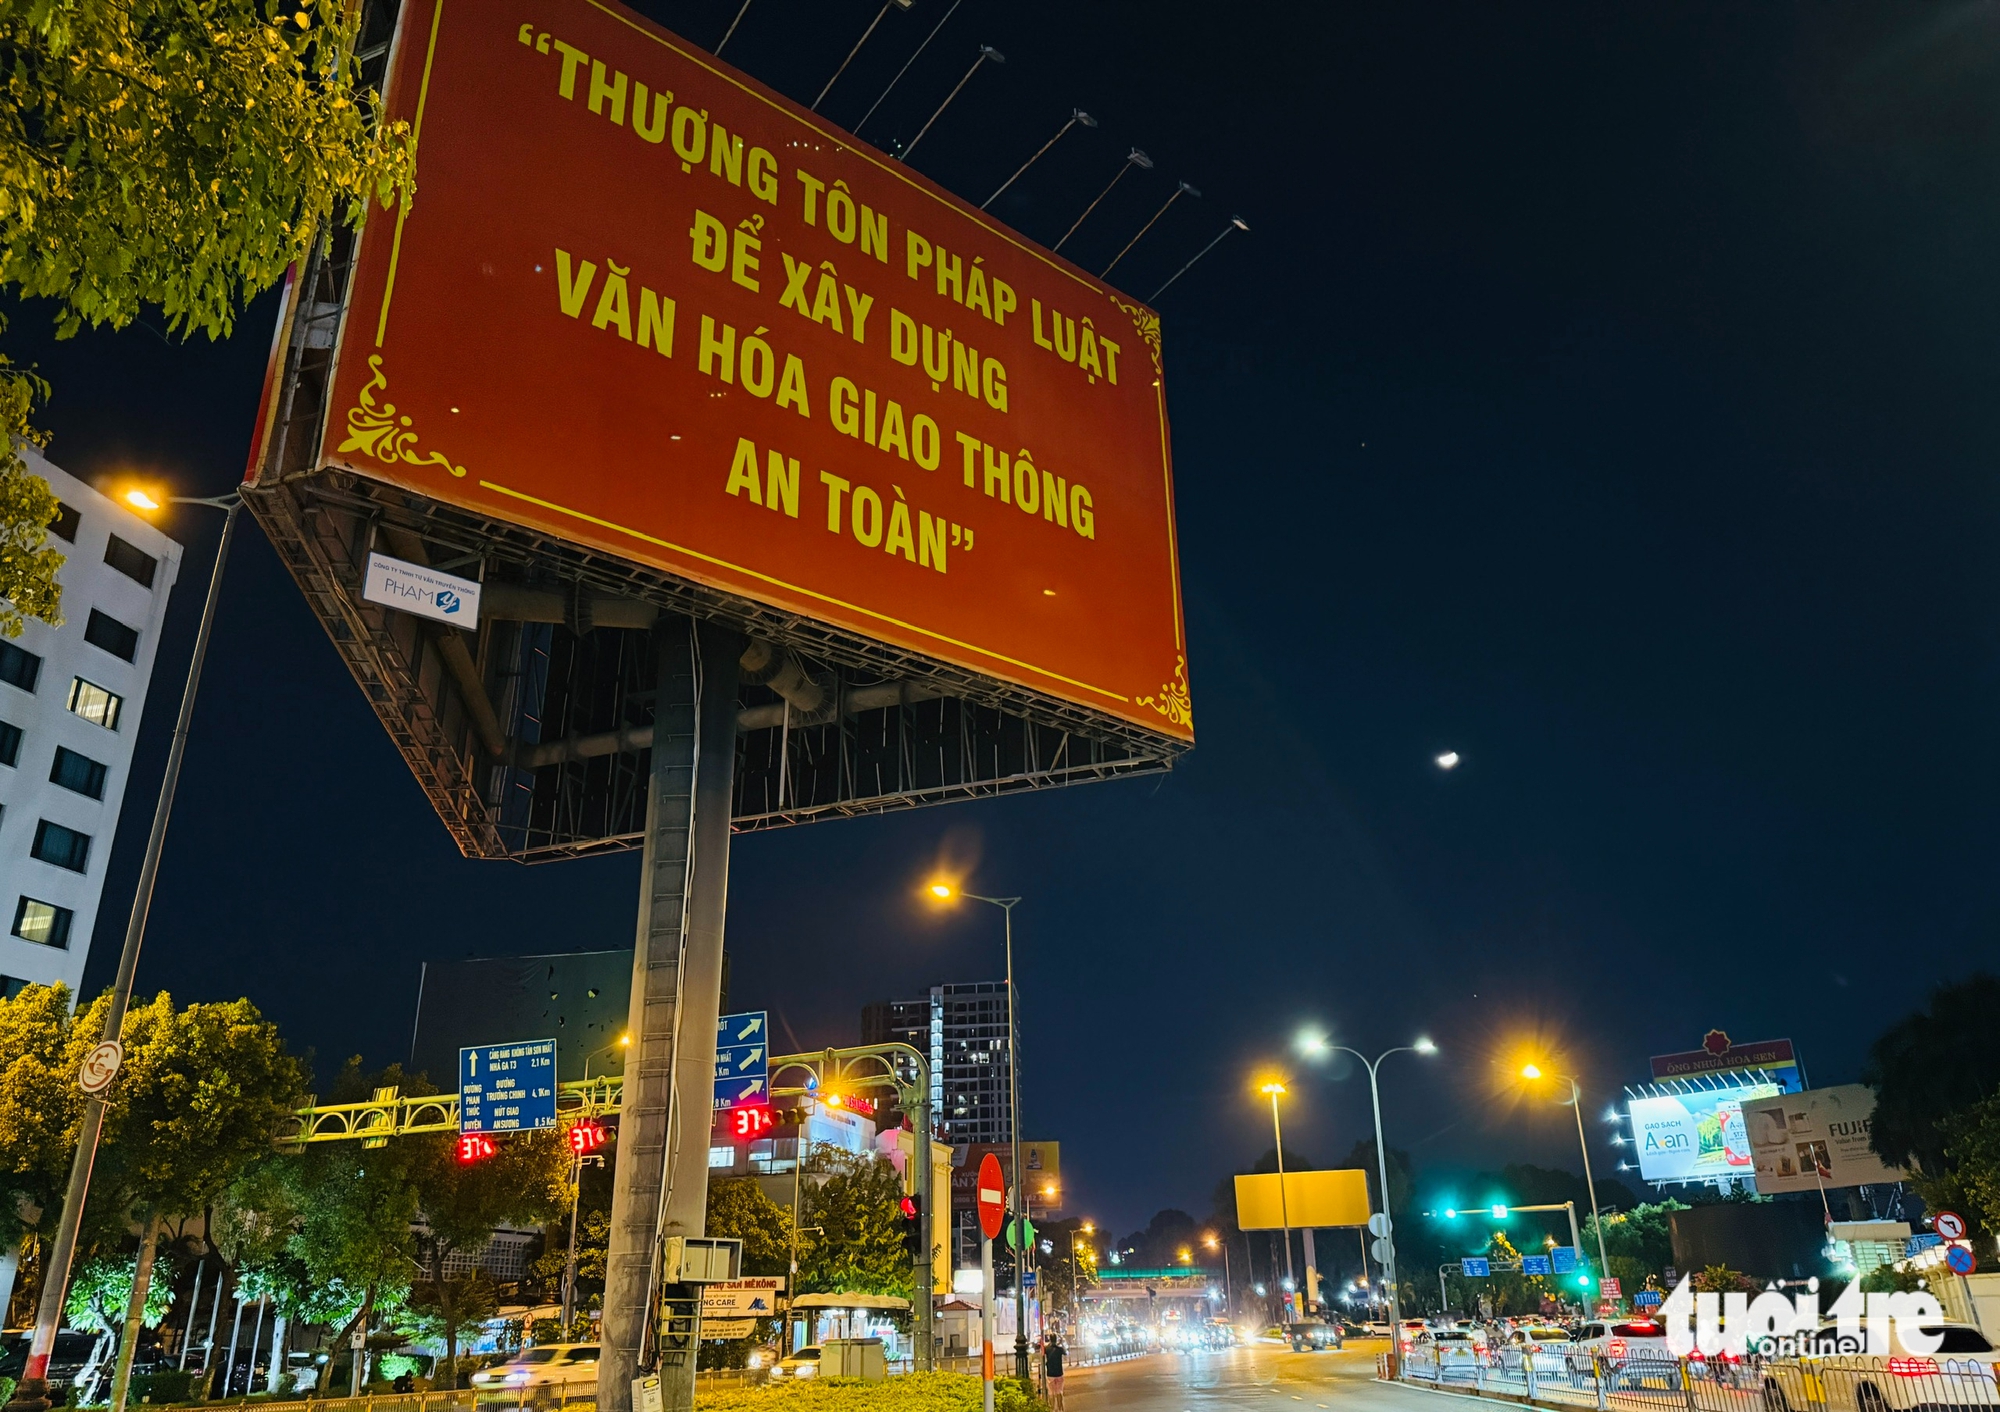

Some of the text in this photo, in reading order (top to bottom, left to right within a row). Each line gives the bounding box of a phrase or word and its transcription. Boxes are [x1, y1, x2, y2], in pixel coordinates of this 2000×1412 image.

[796, 169, 889, 264] TÔN
[906, 229, 1018, 327] PHÁP
[1031, 299, 1122, 386] LUẬT
[689, 209, 1009, 415] ĐỂ XÂY DỰNG
[554, 248, 1096, 540] VĂN HÓA GIAO THÔNG
[725, 437, 801, 519] AN
[720, 1049, 732, 1063] NHẤT
[1727, 1056, 1751, 1066] HOA
[1753, 1051, 1776, 1062] SEN
[489, 1059, 501, 1072] NHÀ
[501, 1061, 509, 1071] GA
[510, 1060, 517, 1070] T3
[540, 1057, 551, 1066] Km
[718, 1067, 729, 1076] Km
[509, 1090, 526, 1099] CHINH
[720, 1098, 731, 1107] Km
[494, 1105, 519, 1117] NÚT GIAO
[546, 1116, 556, 1127] Km
[737, 1109, 759, 1134] 37
[1829, 1118, 1873, 1137] FUJIF
[573, 1128, 593, 1150] 37
[462, 1138, 480, 1159] 37
[744, 1278, 777, 1289] MÊKÔNG
